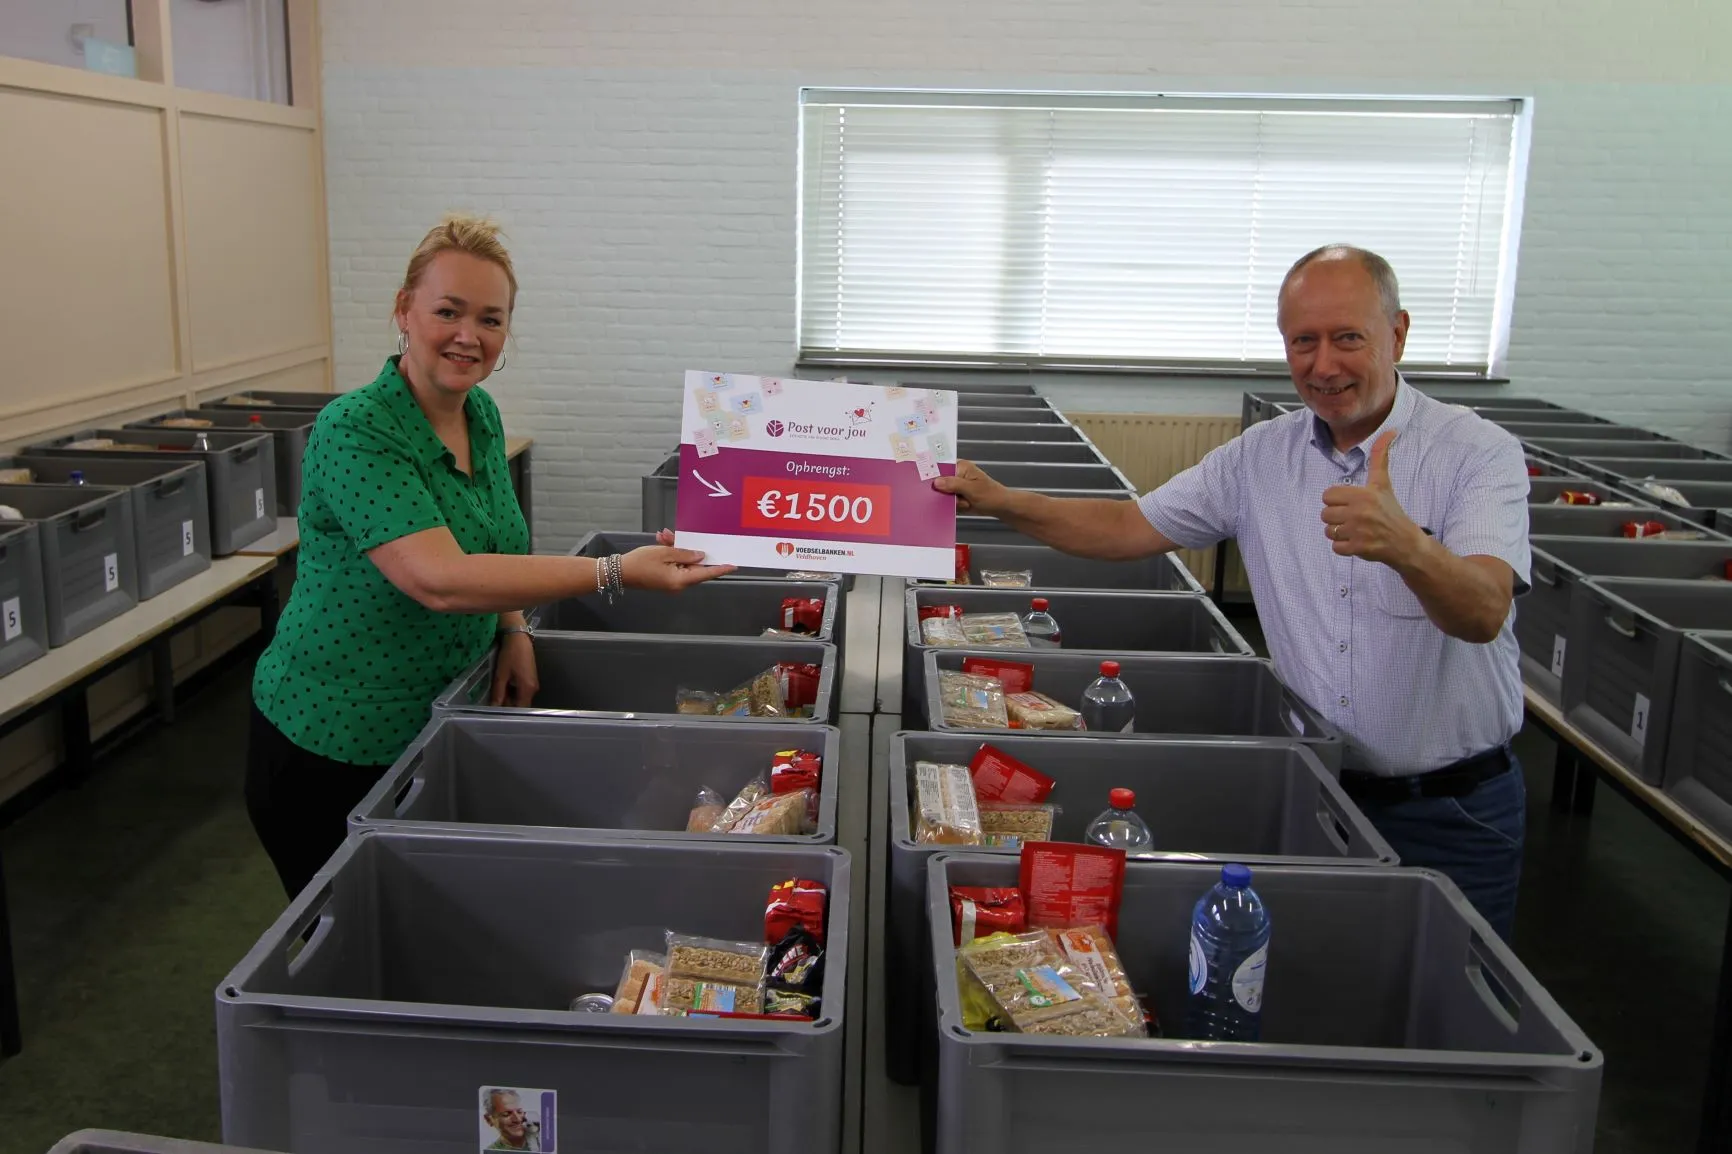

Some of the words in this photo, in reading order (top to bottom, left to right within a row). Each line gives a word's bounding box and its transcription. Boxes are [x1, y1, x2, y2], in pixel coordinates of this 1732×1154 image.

[788, 421, 814, 434] Post
[817, 426, 844, 436] voor
[845, 426, 867, 440] jou
[786, 460, 850, 478] Opbrengst:
[757, 490, 873, 524] €1500
[185, 532, 191, 545] 5
[795, 547, 855, 556] VOEDSELBANKEN.NL
[796, 553, 827, 561] Veldhoven
[109, 566, 116, 581] 5
[9, 611, 16, 628] 5
[1556, 650, 1562, 666] 1
[1636, 711, 1643, 730] 1
